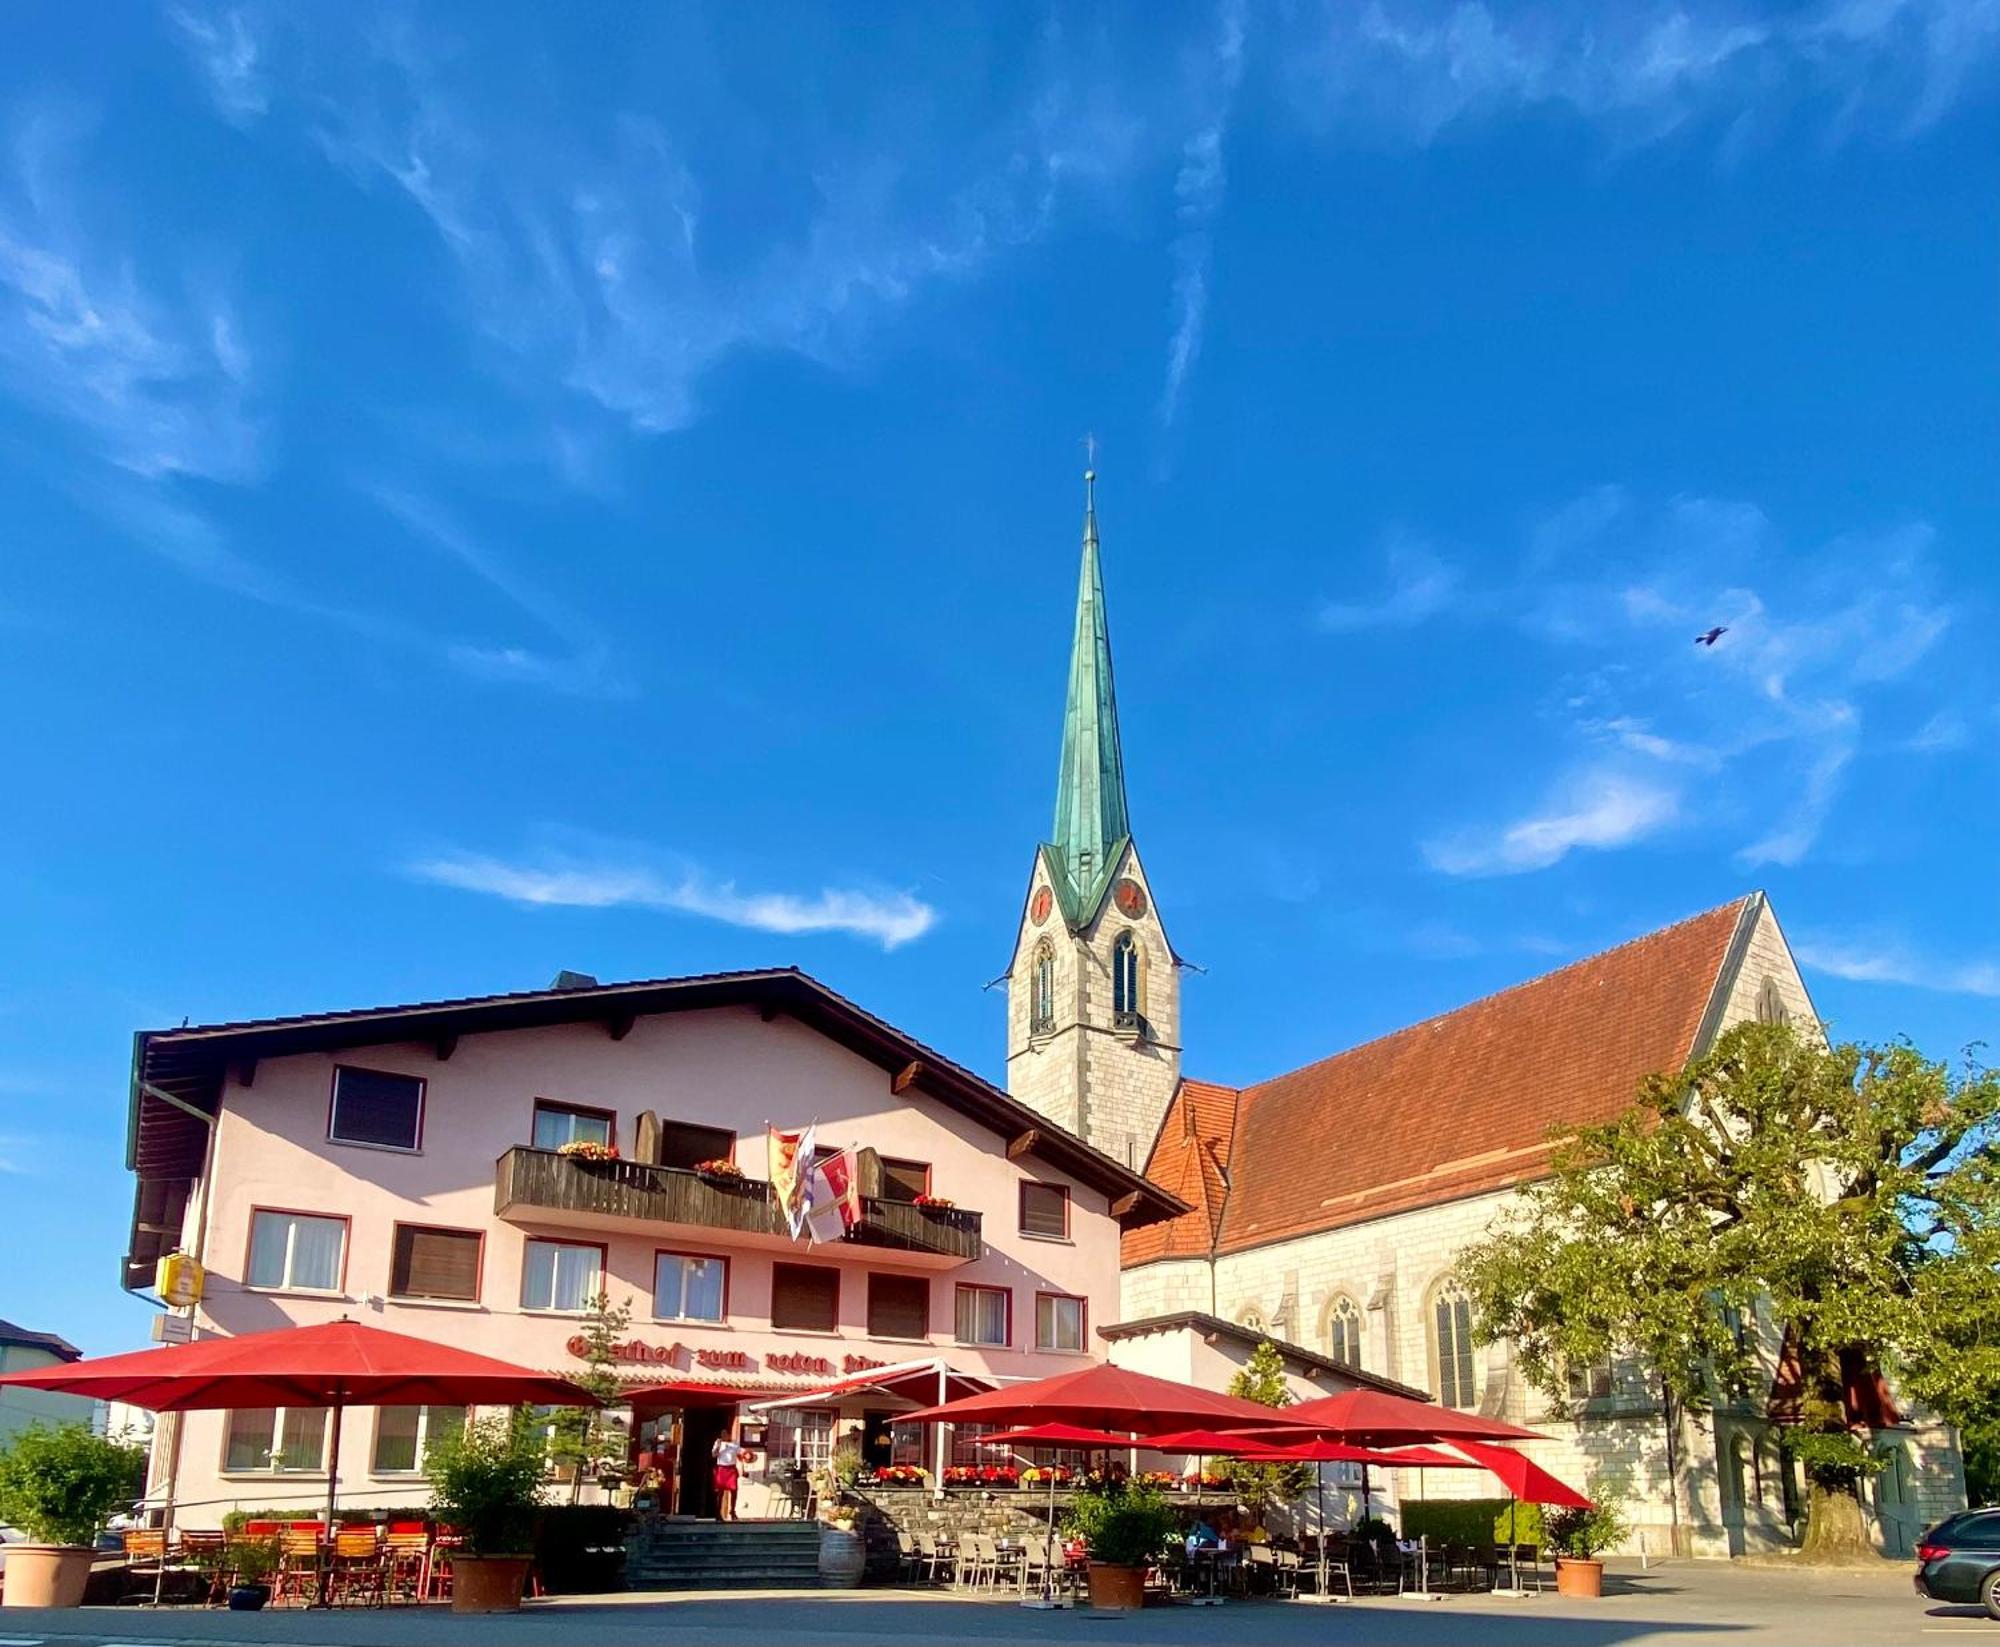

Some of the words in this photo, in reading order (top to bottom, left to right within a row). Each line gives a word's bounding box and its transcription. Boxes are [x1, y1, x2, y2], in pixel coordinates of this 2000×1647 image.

[567, 1335, 682, 1367] Gsthof
[697, 1348, 747, 1367] zum
[765, 1351, 828, 1373] roten
